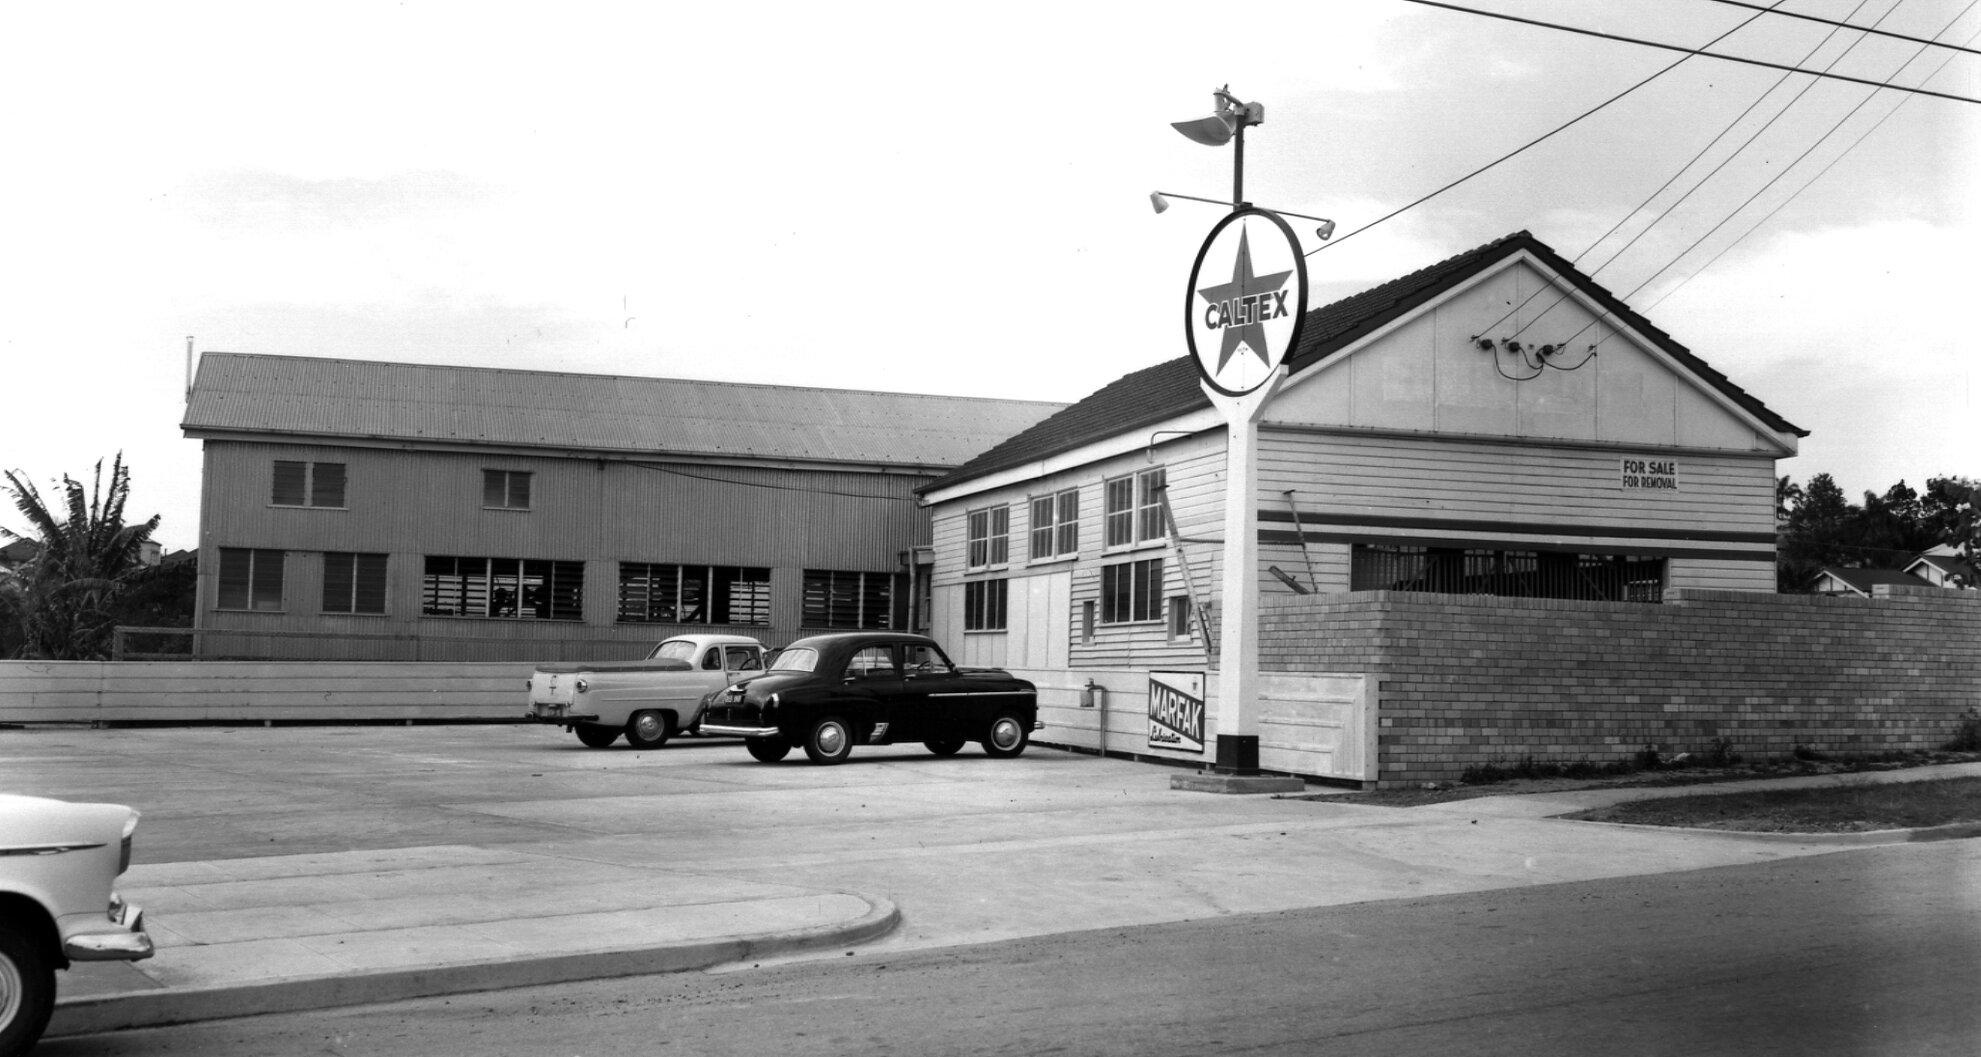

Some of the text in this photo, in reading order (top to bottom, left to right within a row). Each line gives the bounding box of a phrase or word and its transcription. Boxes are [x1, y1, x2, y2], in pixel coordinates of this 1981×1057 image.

[1205, 290, 1288, 329] CALTEX
[1623, 460, 1675, 475] FOR SALE
[1623, 475, 1677, 489] FOR REMOVAL
[1150, 683, 1202, 740] MARFAK
